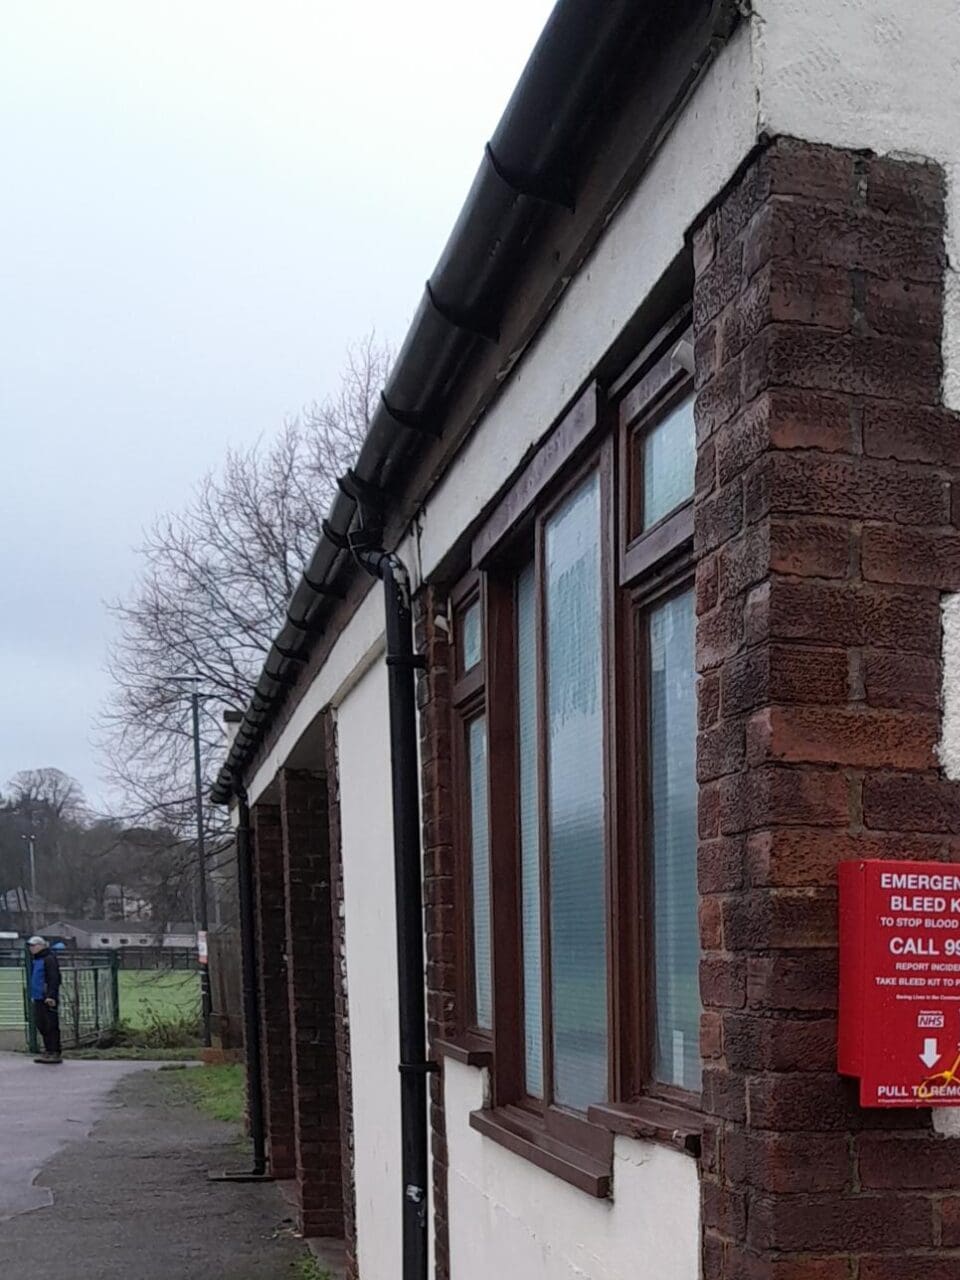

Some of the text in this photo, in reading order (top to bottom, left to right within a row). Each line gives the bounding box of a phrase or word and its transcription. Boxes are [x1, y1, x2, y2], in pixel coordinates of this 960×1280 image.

[890, 895, 946, 913] BLEED
[880, 916, 894, 927] TO
[895, 917, 923, 928] STOP
[924, 918, 959, 929] BLOOD
[889, 936, 940, 956] CALL
[895, 962, 930, 971] REPORT
[875, 977, 897, 986] TAKE
[898, 977, 926, 986] BLEED
[927, 978, 941, 987] KIT
[943, 978, 954, 987] TO
[919, 1016, 943, 1026] NHS
[877, 1085, 909, 1097] PULL
[911, 1085, 929, 1098] TO
